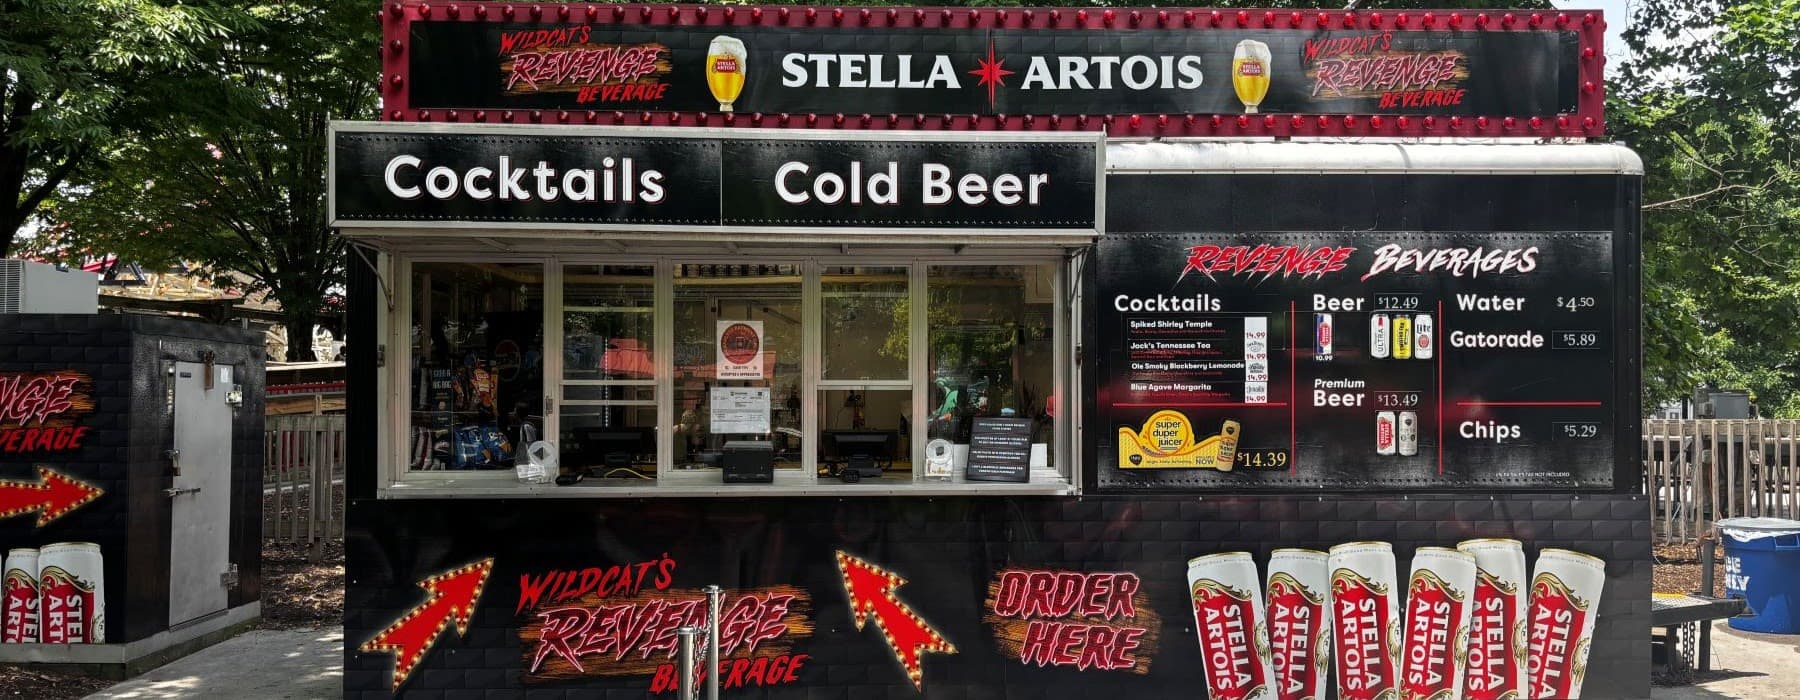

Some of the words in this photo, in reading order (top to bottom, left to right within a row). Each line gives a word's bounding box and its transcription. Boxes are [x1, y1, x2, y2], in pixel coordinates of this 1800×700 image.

[500, 25, 592, 56] WILDCAT'S
[1304, 31, 1393, 64] WILDCAT'S
[507, 46, 662, 91] REVENGE
[781, 52, 962, 89] STELLA
[1020, 54, 1203, 90] ARTOIS
[1312, 53, 1458, 97] REVENGE
[576, 84, 670, 104] BEVERAGE
[1378, 90, 1466, 109] BEVERAGE
[383, 154, 666, 204] Cocktails
[774, 160, 901, 206] Cold
[922, 162, 1050, 207] Beer
[1175, 244, 1358, 286] REVENGE
[1361, 243, 1539, 282] BEVERAGES
[1114, 293, 1222, 312] Cocktails
[1313, 294, 1365, 311] Beer
[1378, 296, 1419, 310] $12.49
[1456, 293, 1526, 312] Water
[1130, 320, 1156, 329] Spiked
[1158, 320, 1184, 329] Shirley
[1185, 320, 1213, 329] Temple
[1416, 324, 1430, 334] Lite
[1450, 330, 1545, 348] Gatorade
[1563, 333, 1596, 347] $5.89
[1144, 362, 1168, 372] Smoky
[1170, 362, 1208, 371] Blackberry
[1130, 383, 1148, 391] Blue
[1148, 383, 1172, 392] Agave
[1174, 383, 1212, 392] Margarita
[1314, 378, 1366, 389] Premium
[1313, 390, 1366, 407] Beer
[1378, 394, 1418, 407] $13.49
[1152, 428, 1178, 439] duper
[1156, 420, 1182, 430] super
[1459, 420, 1521, 444] Chips
[1564, 424, 1598, 438] $5.29
[1158, 438, 1182, 447] juicer
[1237, 452, 1286, 467] $14.39
[515, 552, 677, 612] WILDCAT'S
[995, 571, 1140, 619] ORDER
[49, 595, 64, 643] ART
[1020, 620, 1146, 671] HERE
[1204, 607, 1232, 690] ARTOIS
[1223, 604, 1252, 689] STELLA
[1286, 605, 1310, 695] STELLA
[1341, 599, 1362, 691] ARTOIS
[1358, 598, 1382, 689] STELLA
[1408, 598, 1430, 685] ARTOIS
[1426, 600, 1451, 686] STELLA
[1486, 597, 1504, 690] STELLA
[1538, 608, 1572, 699] STELLA
